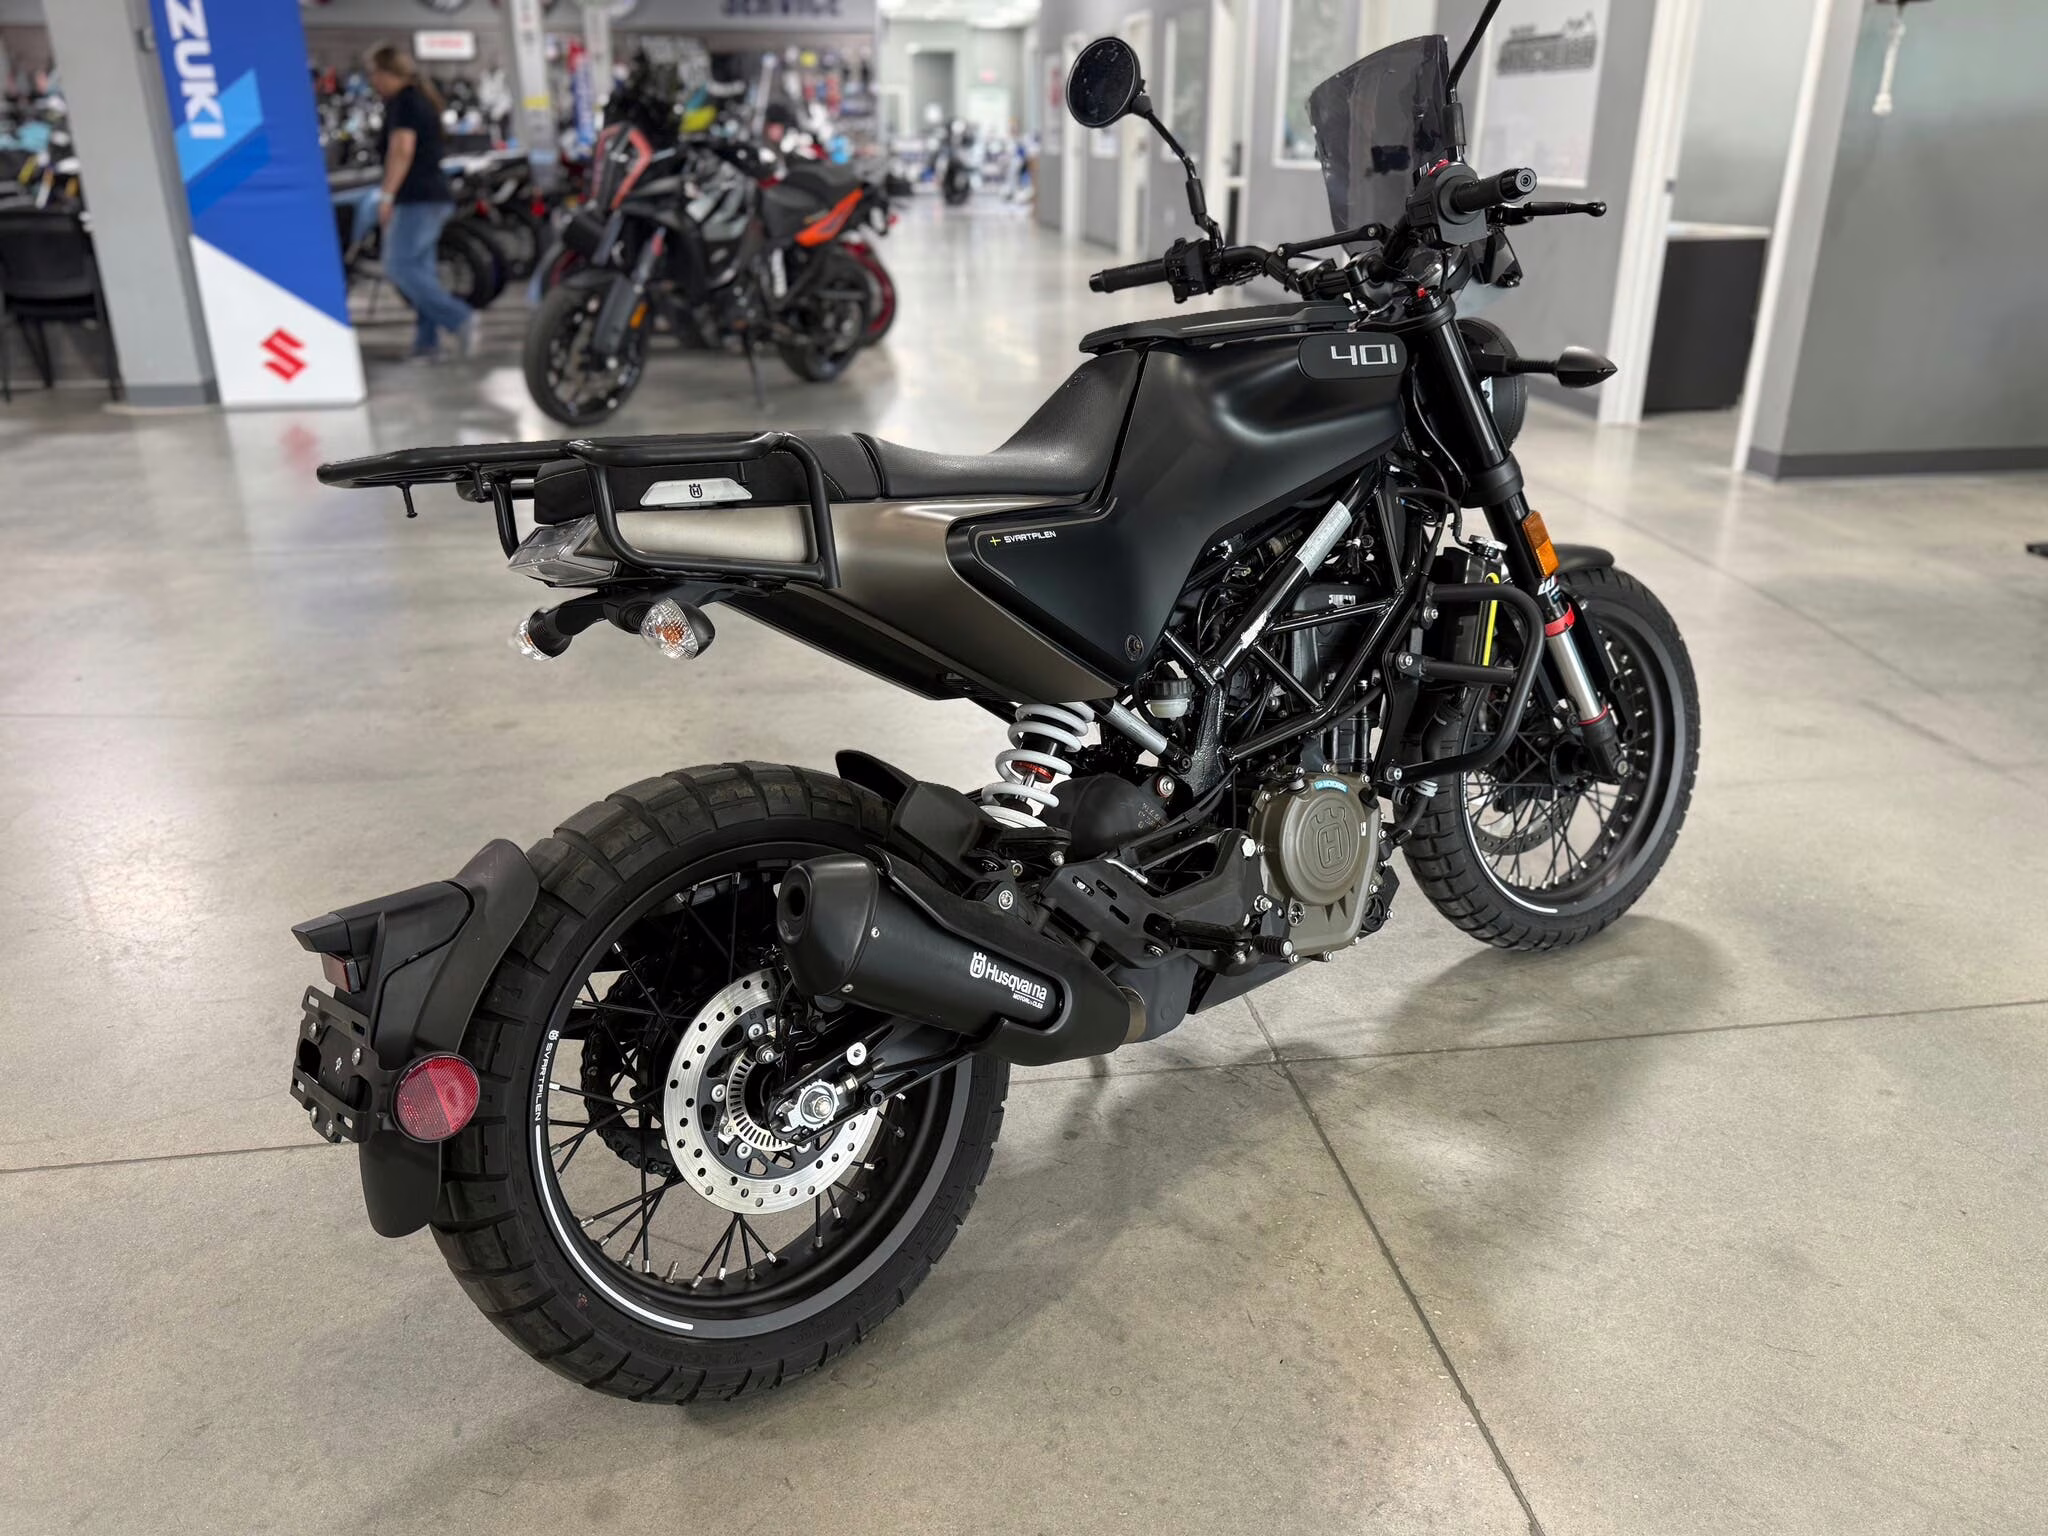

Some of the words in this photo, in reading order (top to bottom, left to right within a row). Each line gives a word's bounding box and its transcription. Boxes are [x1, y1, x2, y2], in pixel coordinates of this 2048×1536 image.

[1330, 343, 1398, 366] 401
[1003, 530, 1057, 544] SVARTPILEN
[985, 962, 1048, 1001] Husqvarna
[535, 1042, 554, 1122] SVARTPILEN
